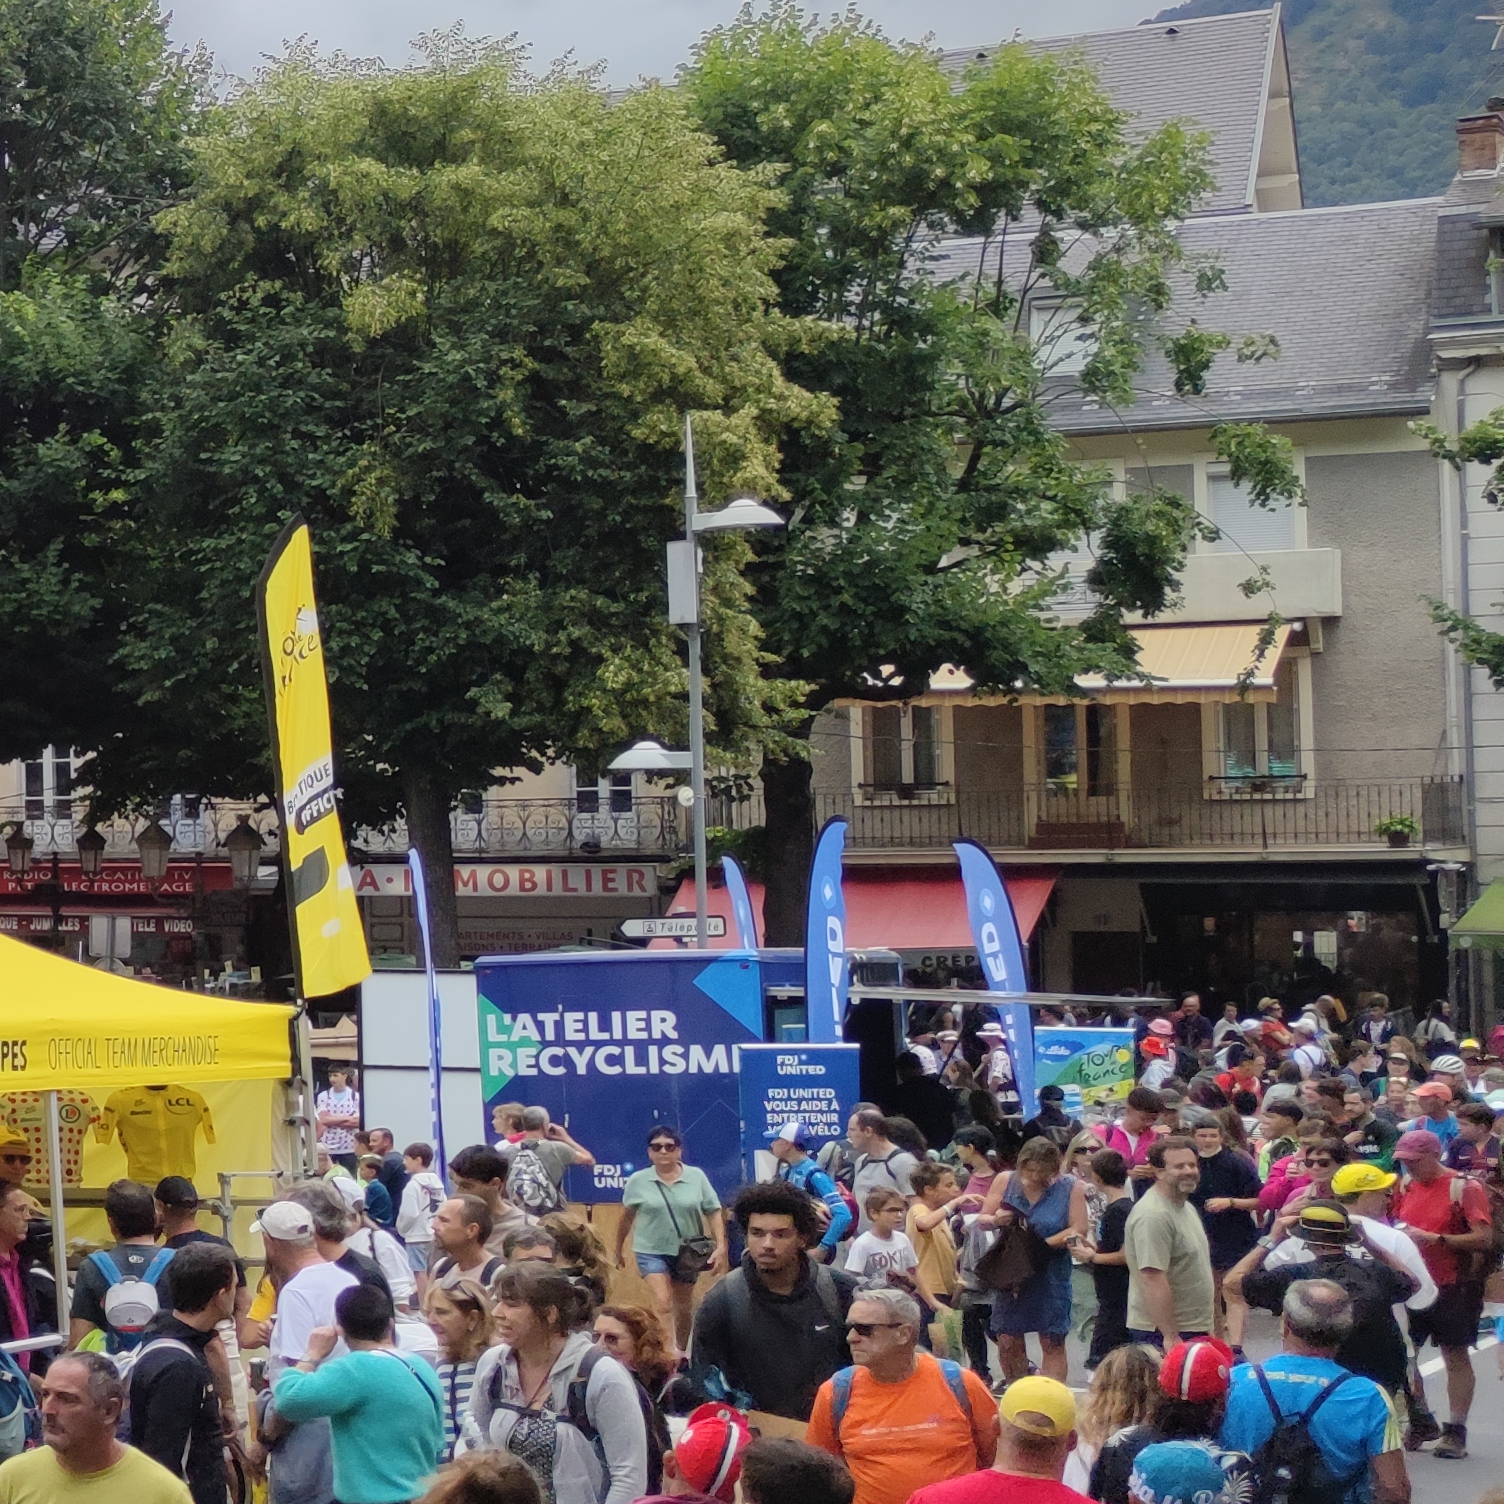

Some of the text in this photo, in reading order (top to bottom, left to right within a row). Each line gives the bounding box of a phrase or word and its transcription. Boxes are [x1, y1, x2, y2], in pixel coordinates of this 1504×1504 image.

[174, 870, 192, 880] TV
[403, 868, 648, 893] IMOBILIER
[534, 930, 574, 942] VILLAS
[486, 1009, 679, 1043] L'ATELIER
[47, 1036, 101, 1070] OFFICIAL
[104, 1036, 138, 1068] TEAM
[139, 1034, 220, 1067] MERCHANDISE
[776, 1054, 799, 1066] FDJ
[777, 1063, 826, 1075] UNITED
[790, 1088, 835, 1099] UNITED
[764, 1099, 799, 1112] VOUS
[800, 1099, 829, 1111] AIDE
[593, 1164, 622, 1177] FDJ
